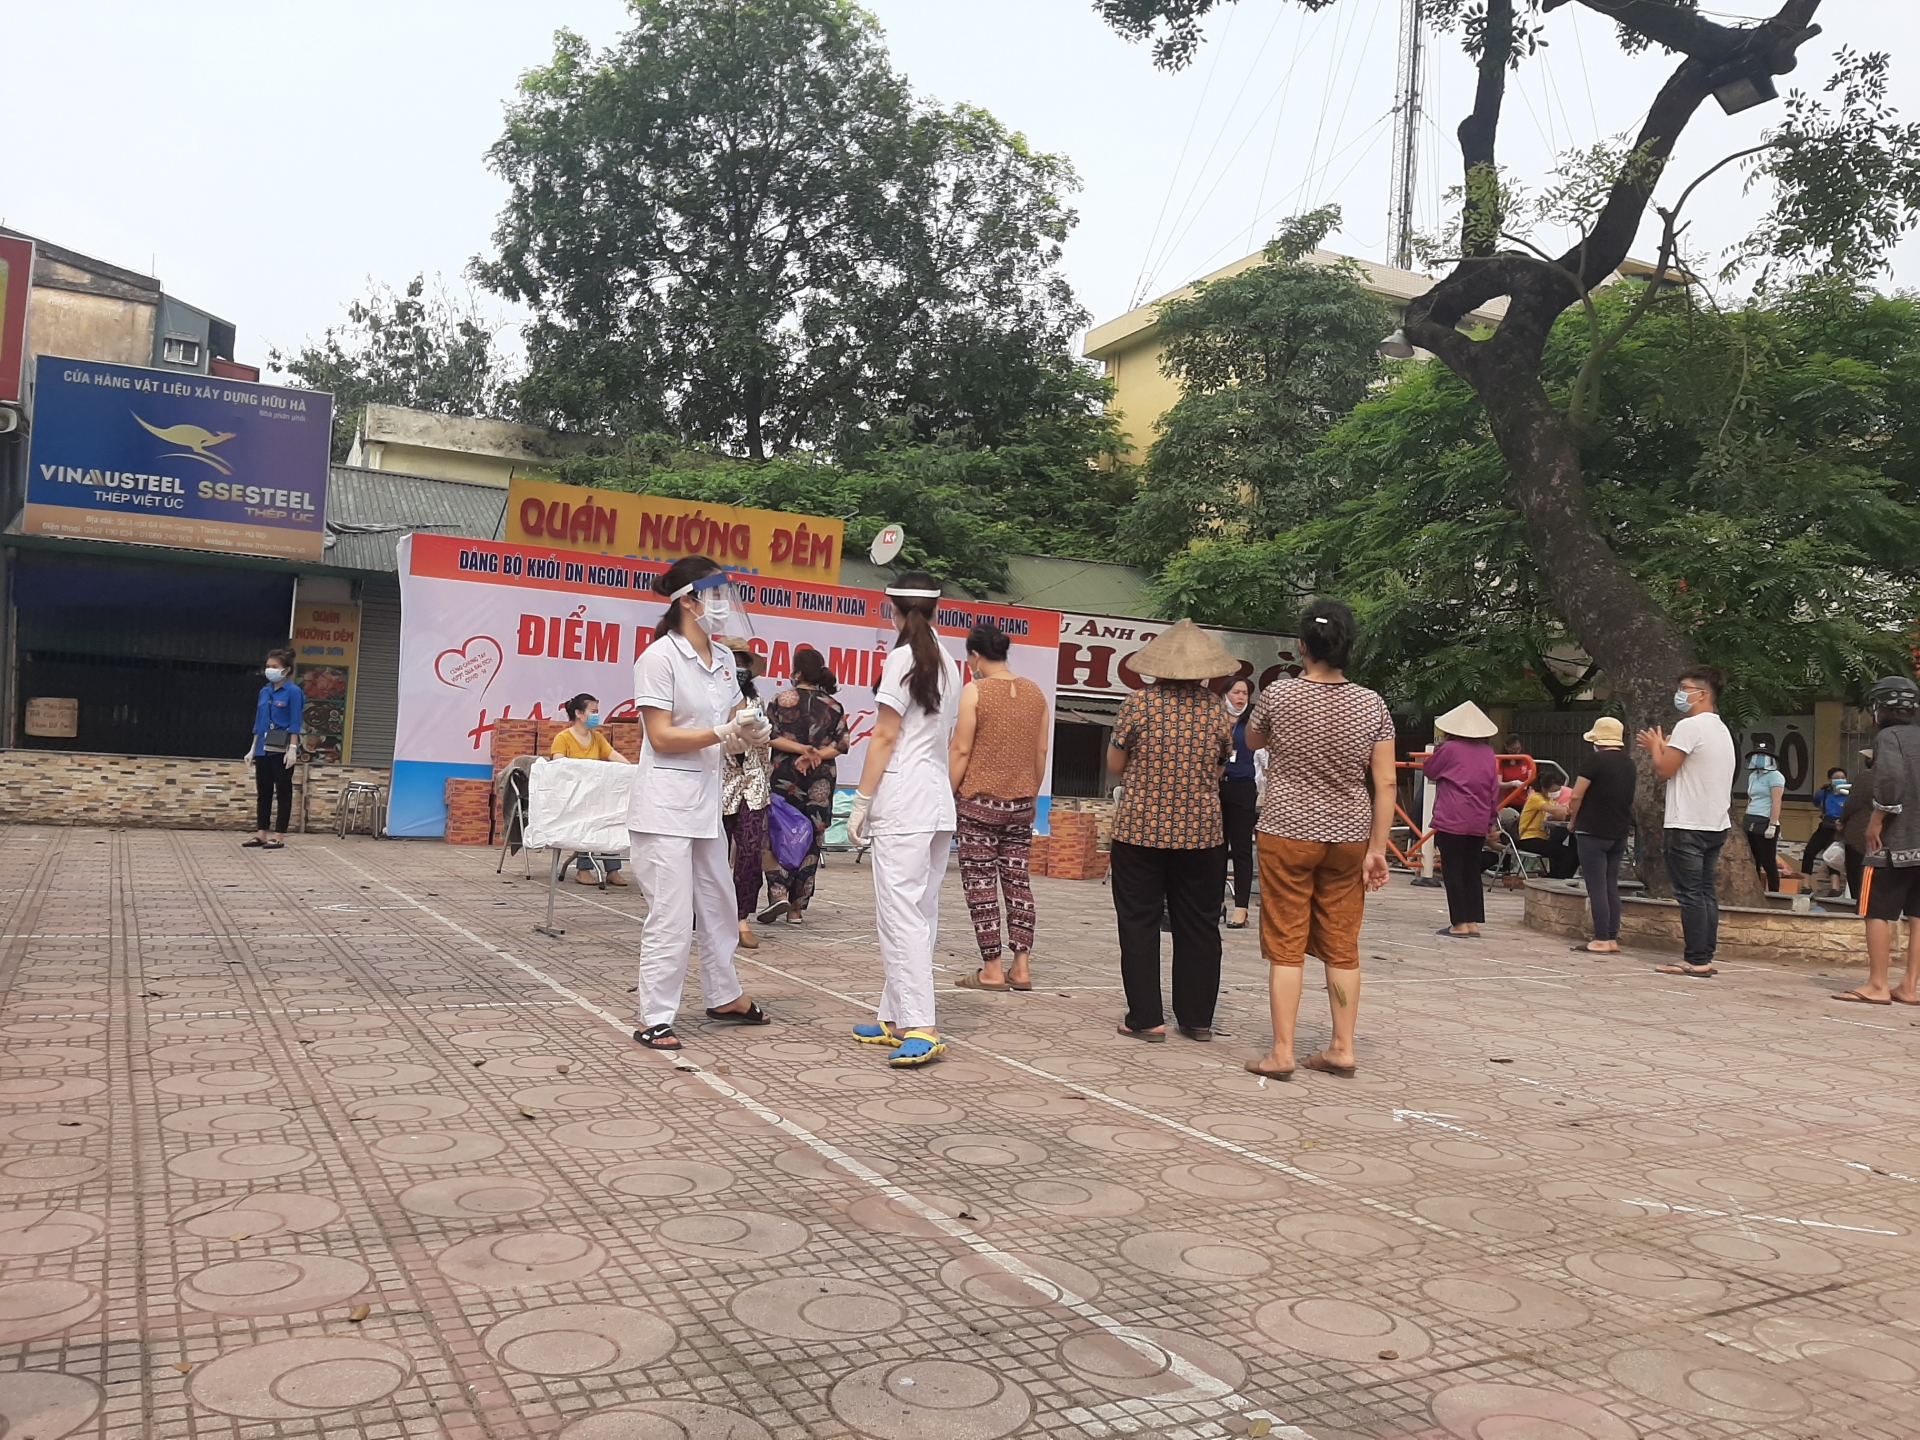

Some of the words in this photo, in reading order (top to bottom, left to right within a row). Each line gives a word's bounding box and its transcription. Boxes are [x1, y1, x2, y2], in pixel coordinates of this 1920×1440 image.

[63, 368, 91, 384] CỬA
[94, 373, 131, 389] HÀNG
[134, 378, 160, 393] VẬT
[162, 382, 191, 397] LIỆU
[195, 385, 220, 399] XÂY
[223, 390, 258, 405] DỰNG
[261, 395, 286, 409] HỮU
[289, 398, 307, 412] HÀ
[94, 490, 130, 503] THÉP
[132, 493, 162, 508] VIỆT
[164, 495, 184, 509] ÚC
[197, 480, 315, 511] SSESTEEL
[244, 506, 288, 519] THÉP
[292, 510, 314, 523] ÚC
[520, 495, 617, 545] QUÁN
[638, 509, 750, 560] NƯỚNG
[768, 522, 834, 568] ĐÊM
[459, 546, 498, 574] ĐẢNG
[502, 553, 523, 580] BỘ
[526, 553, 560, 581] KHỐI
[564, 561, 584, 583] DN
[587, 565, 629, 589] NGOÀI
[632, 569, 661, 591] KH
[760, 584, 792, 611] QUẬN
[795, 590, 833, 613] THANH
[836, 594, 866, 617] XUÂN
[997, 616, 1029, 636] GIANG
[517, 604, 621, 664] ĐIỂM
[829, 639, 888, 687] MIỄ
